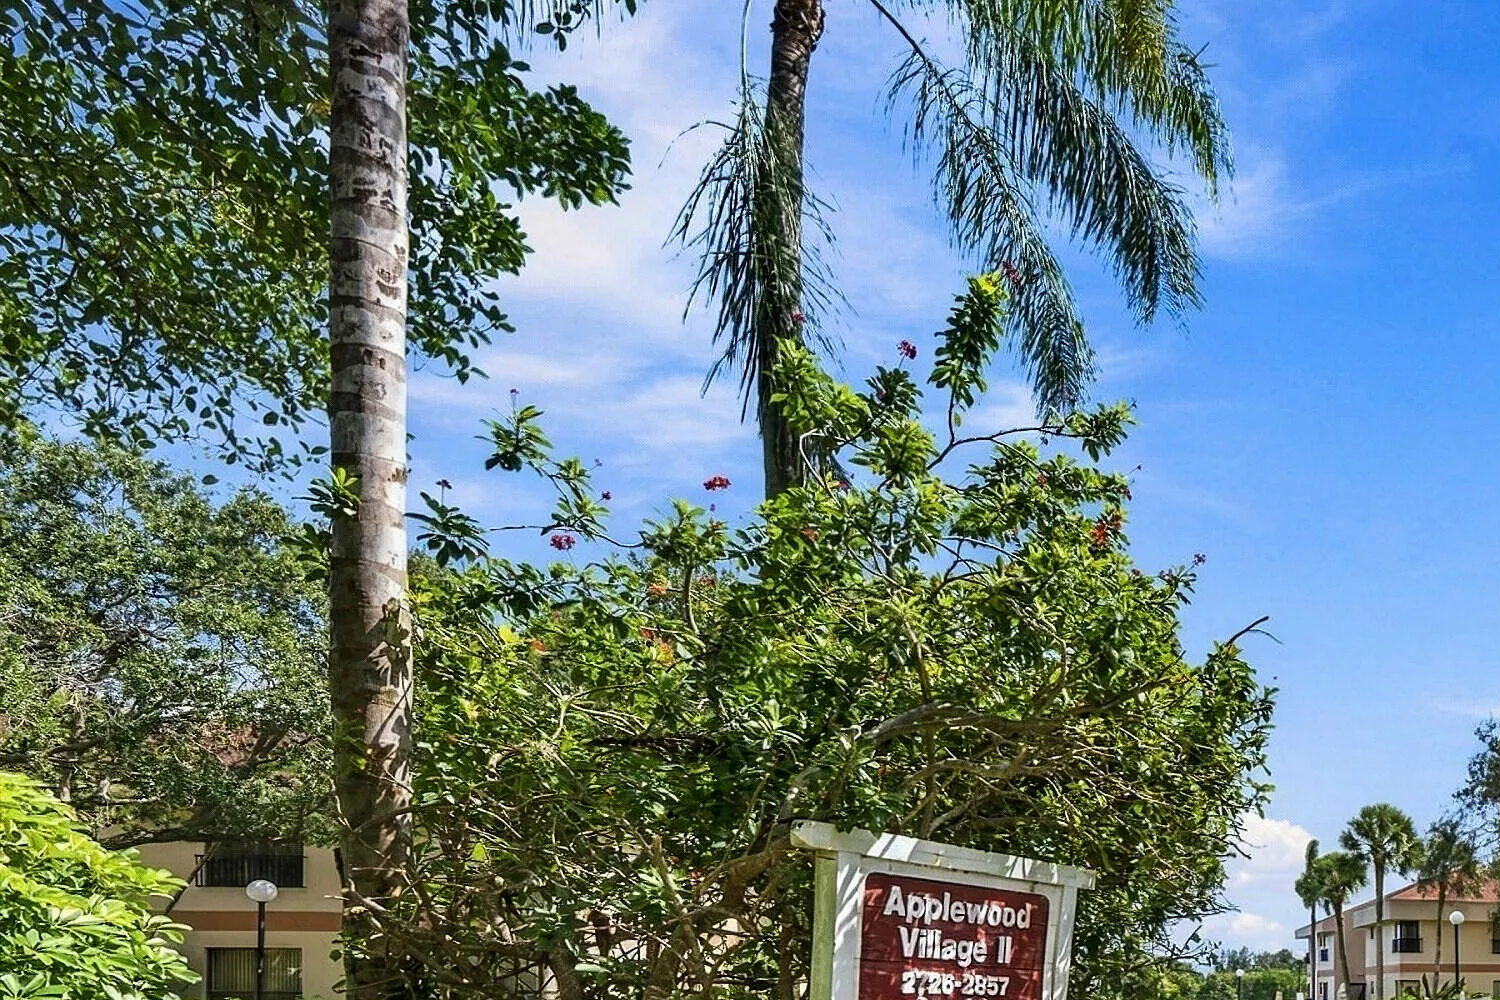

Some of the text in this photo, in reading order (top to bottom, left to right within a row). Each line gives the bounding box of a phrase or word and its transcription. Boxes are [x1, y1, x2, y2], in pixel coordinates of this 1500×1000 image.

[883, 885, 1032, 929] Applewood
[897, 925, 988, 968] Village
[901, 970, 1010, 997] 2726-2857
